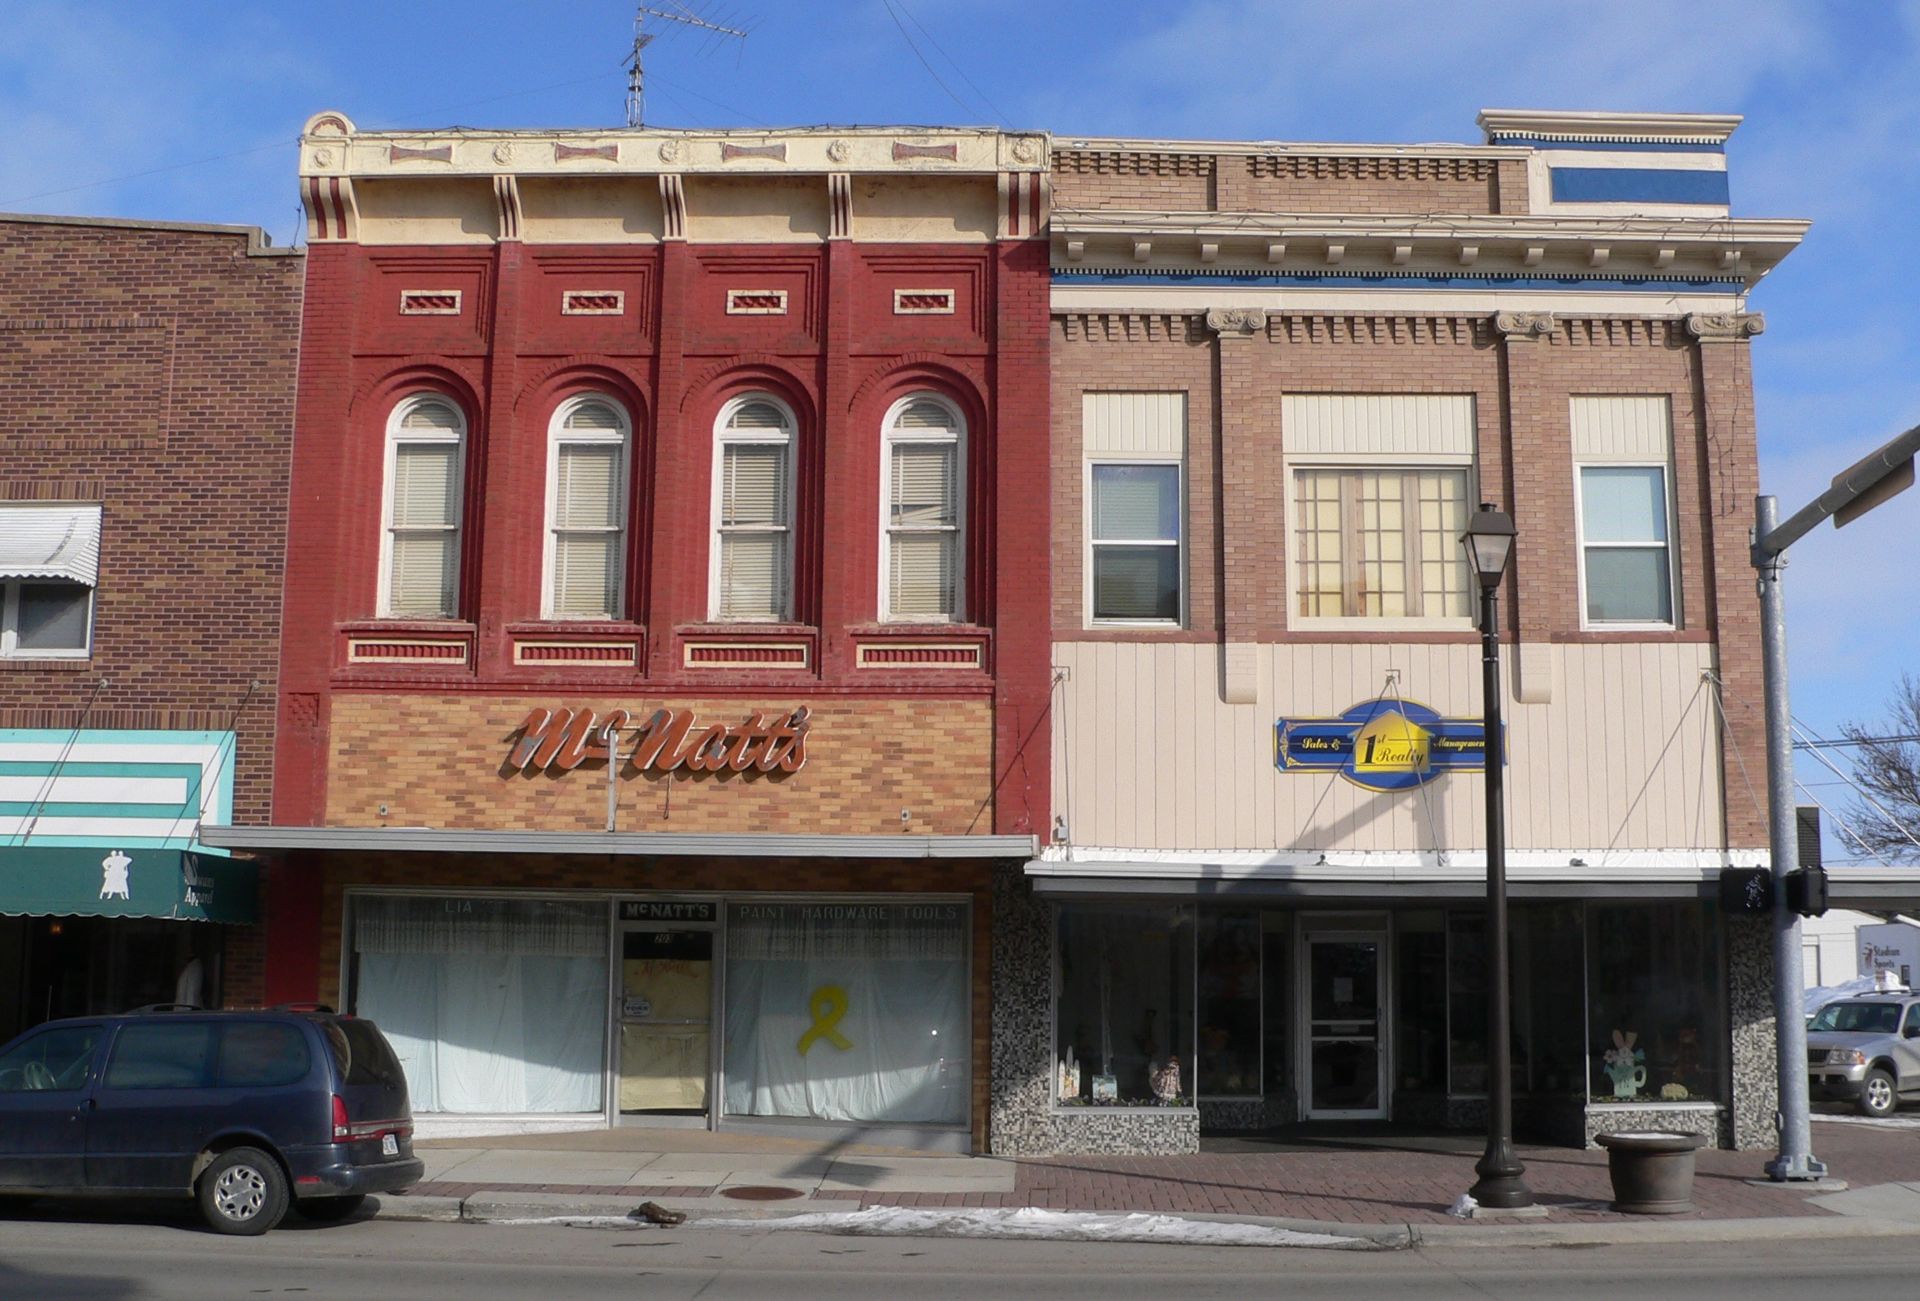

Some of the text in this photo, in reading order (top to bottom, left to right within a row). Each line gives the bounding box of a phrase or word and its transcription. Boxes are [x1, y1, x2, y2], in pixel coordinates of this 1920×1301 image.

[1302, 737, 1486, 751] Sales & Managemen
[1376, 747, 1424, 767] Realty
[740, 906, 957, 920] PAINT HARDWARE TOOLS
